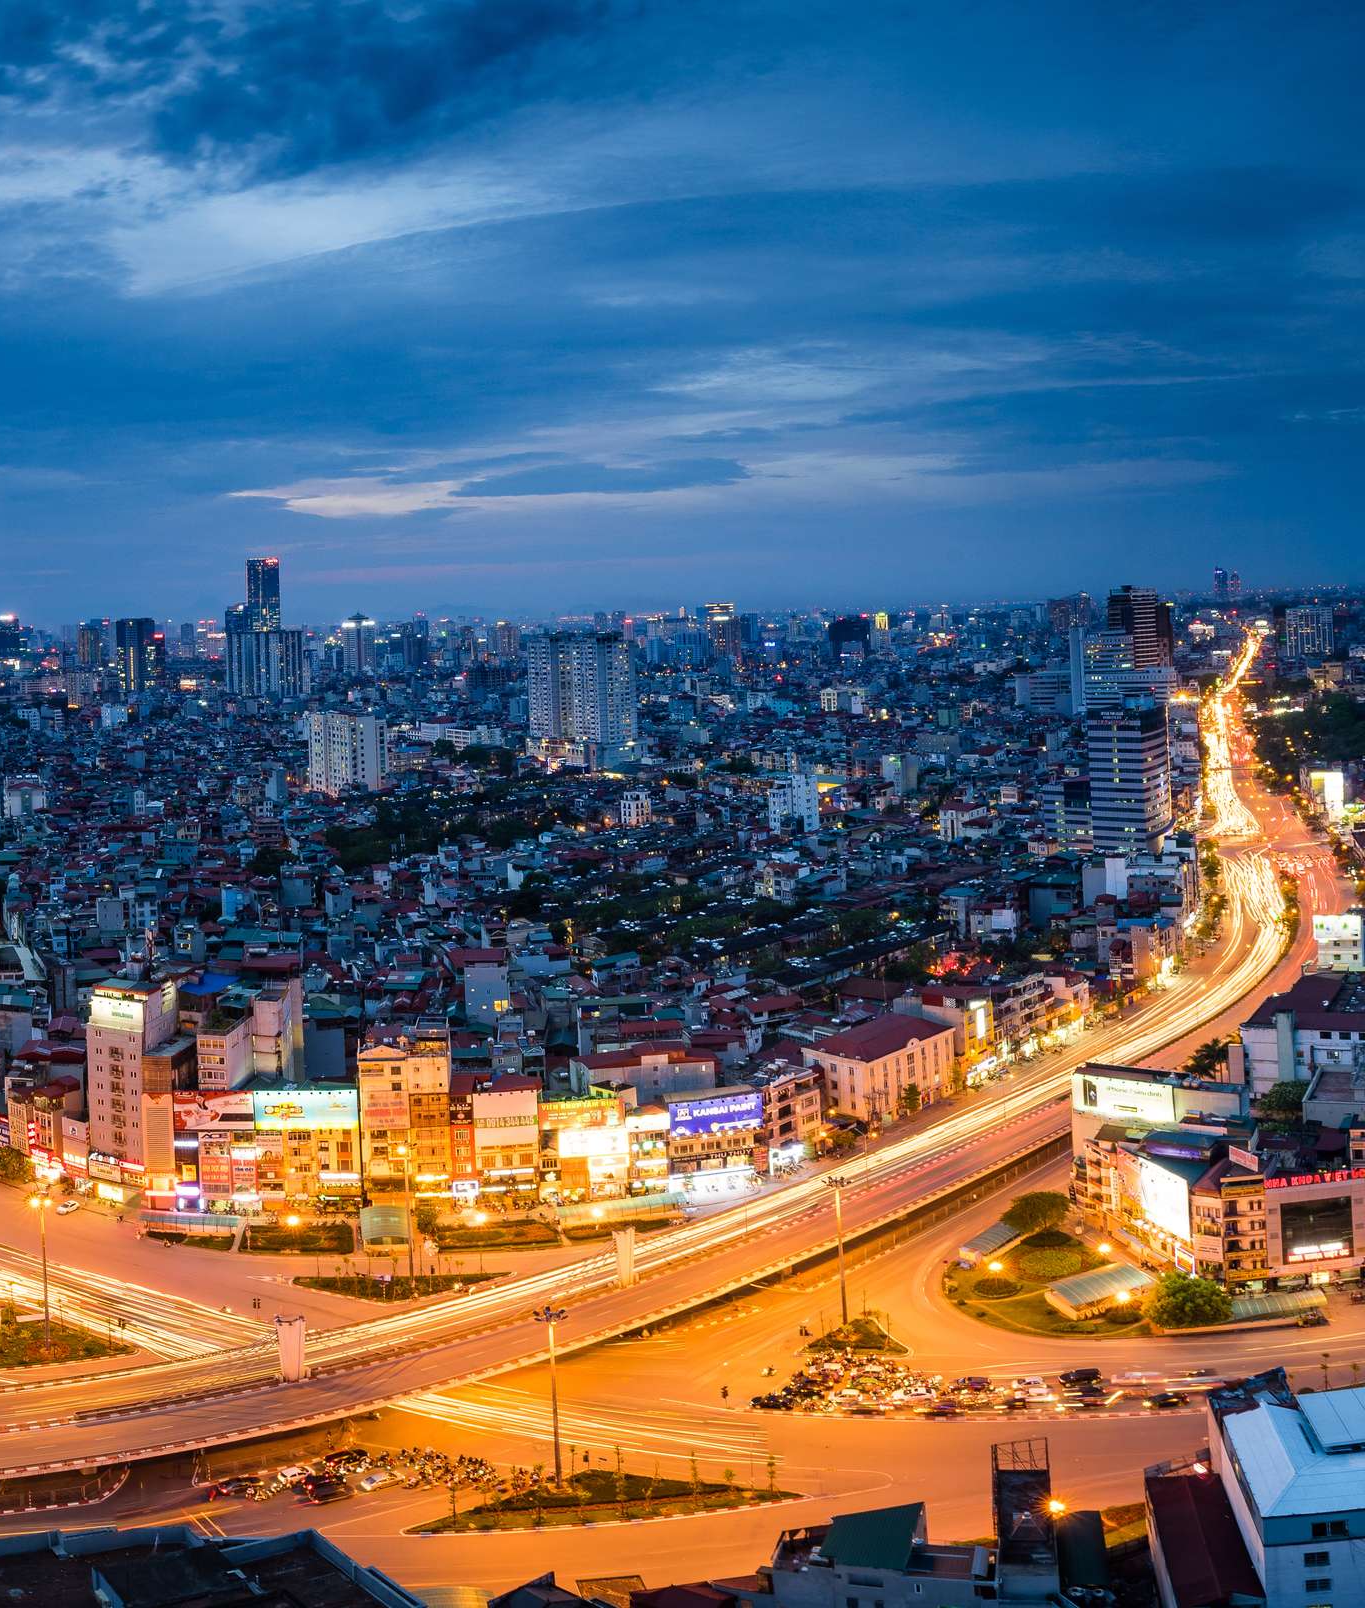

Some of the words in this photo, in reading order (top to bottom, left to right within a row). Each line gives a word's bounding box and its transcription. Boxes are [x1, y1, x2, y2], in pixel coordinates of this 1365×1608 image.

[692, 1105, 728, 1117] KANSAI
[729, 1102, 757, 1113] PAINT
[1263, 1177, 1288, 1189] NHA
[1291, 1173, 1321, 1186] KHOA
